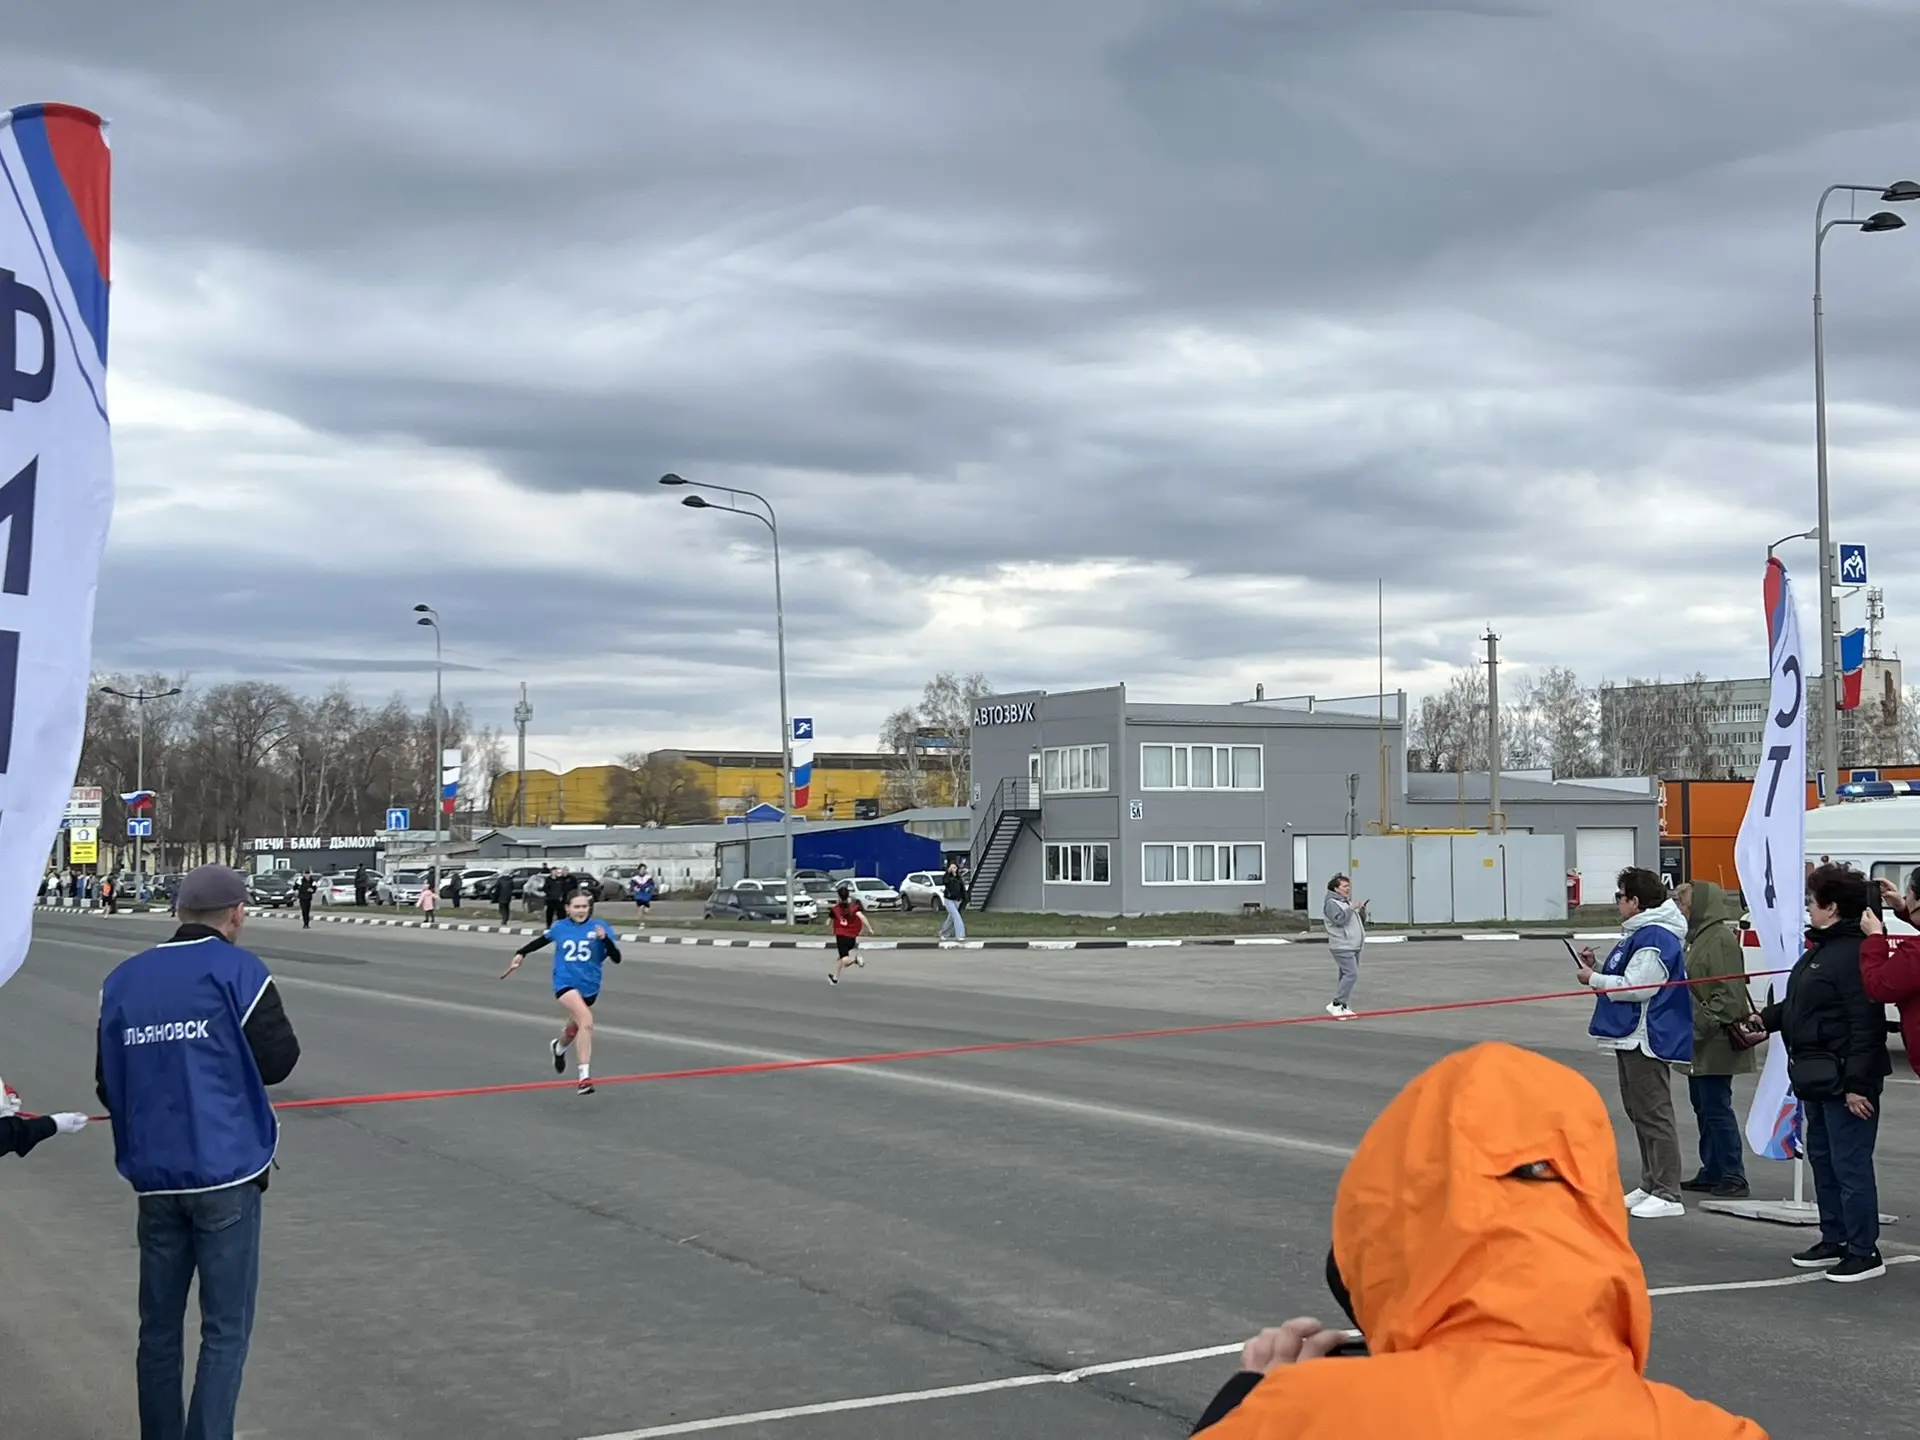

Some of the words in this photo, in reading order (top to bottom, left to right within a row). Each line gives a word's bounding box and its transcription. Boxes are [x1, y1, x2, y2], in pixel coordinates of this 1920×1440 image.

[973, 702, 1036, 727] АВТОЗВУК
[254, 837, 284, 850] ПЕЧИ
[290, 836, 321, 850] БАКИ
[562, 939, 592, 962] 25
[124, 1019, 209, 1046] ЛЬЯНОВСК
